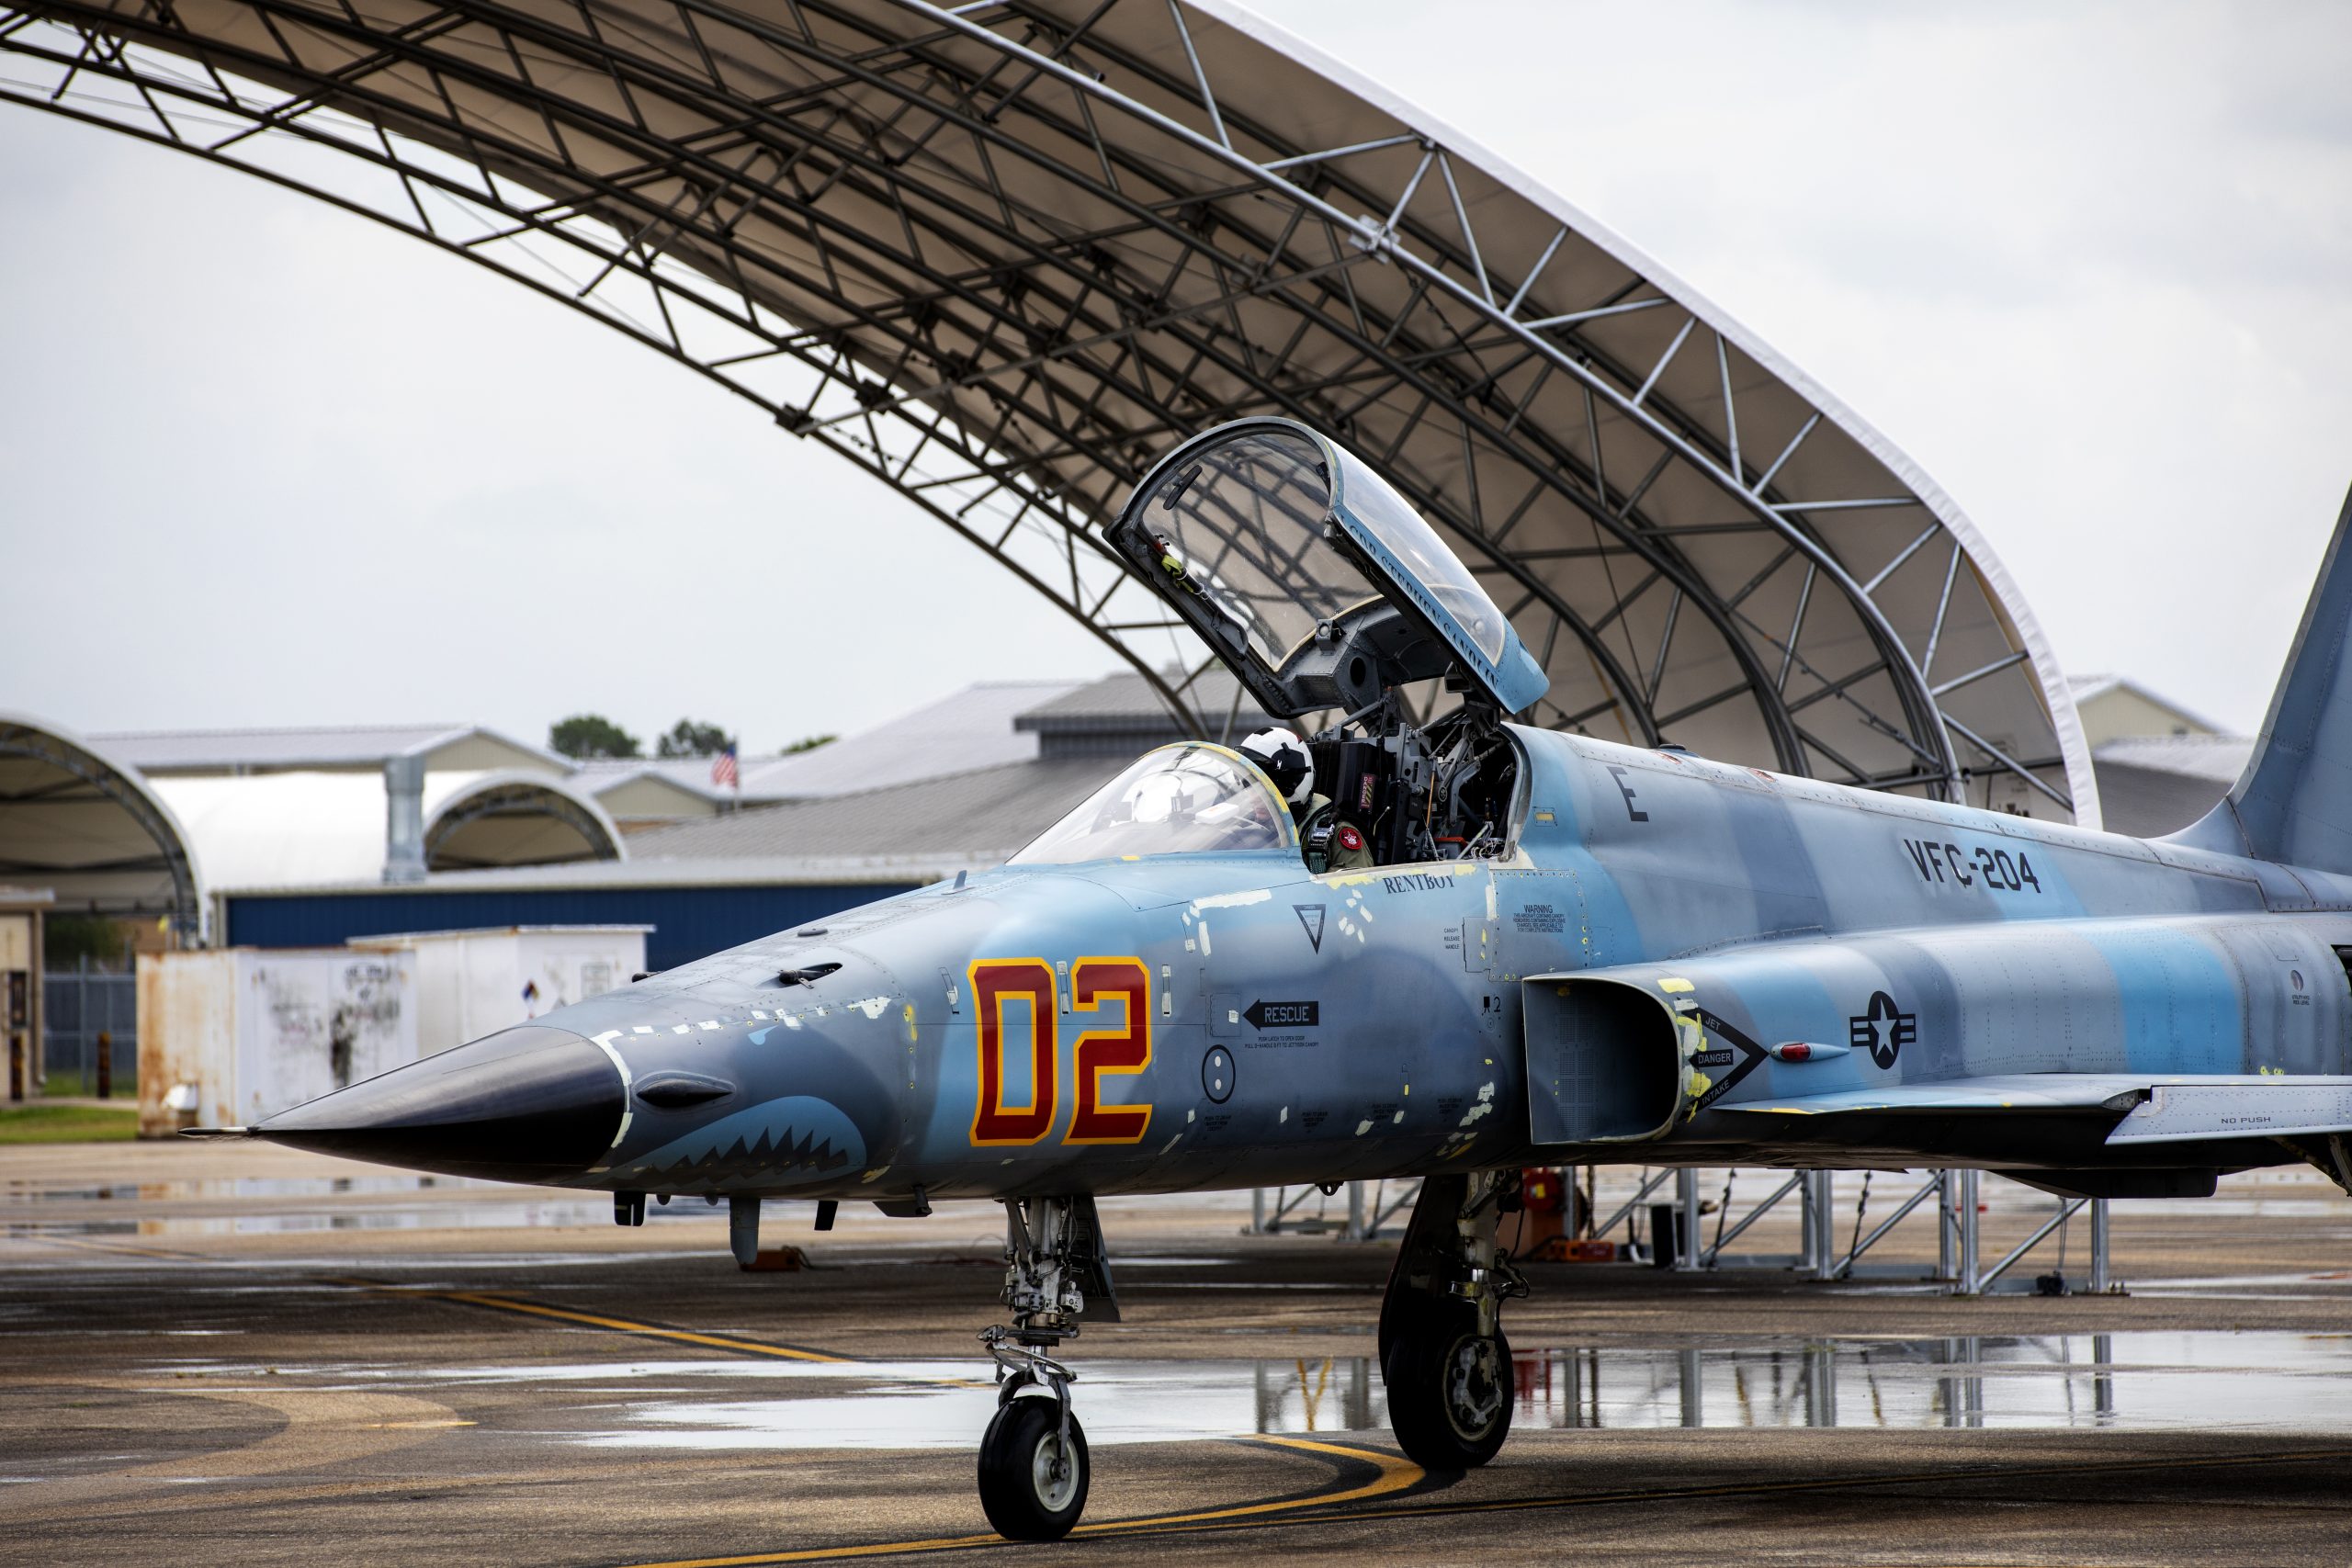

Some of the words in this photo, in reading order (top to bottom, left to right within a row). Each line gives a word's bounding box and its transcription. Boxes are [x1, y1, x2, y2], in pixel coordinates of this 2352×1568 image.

[1605, 766, 1649, 821] E
[1904, 839, 2041, 893] VFC-204
[1382, 873, 1454, 894] RENTBOY
[1523, 904, 1554, 914] WARNING
[1264, 1006, 1309, 1023] RESCUE
[1705, 1017, 1721, 1031] JET
[967, 956, 1153, 1146] 02
[1698, 1054, 1732, 1064] DANGER
[1702, 1079, 1730, 1105] INTAKE
